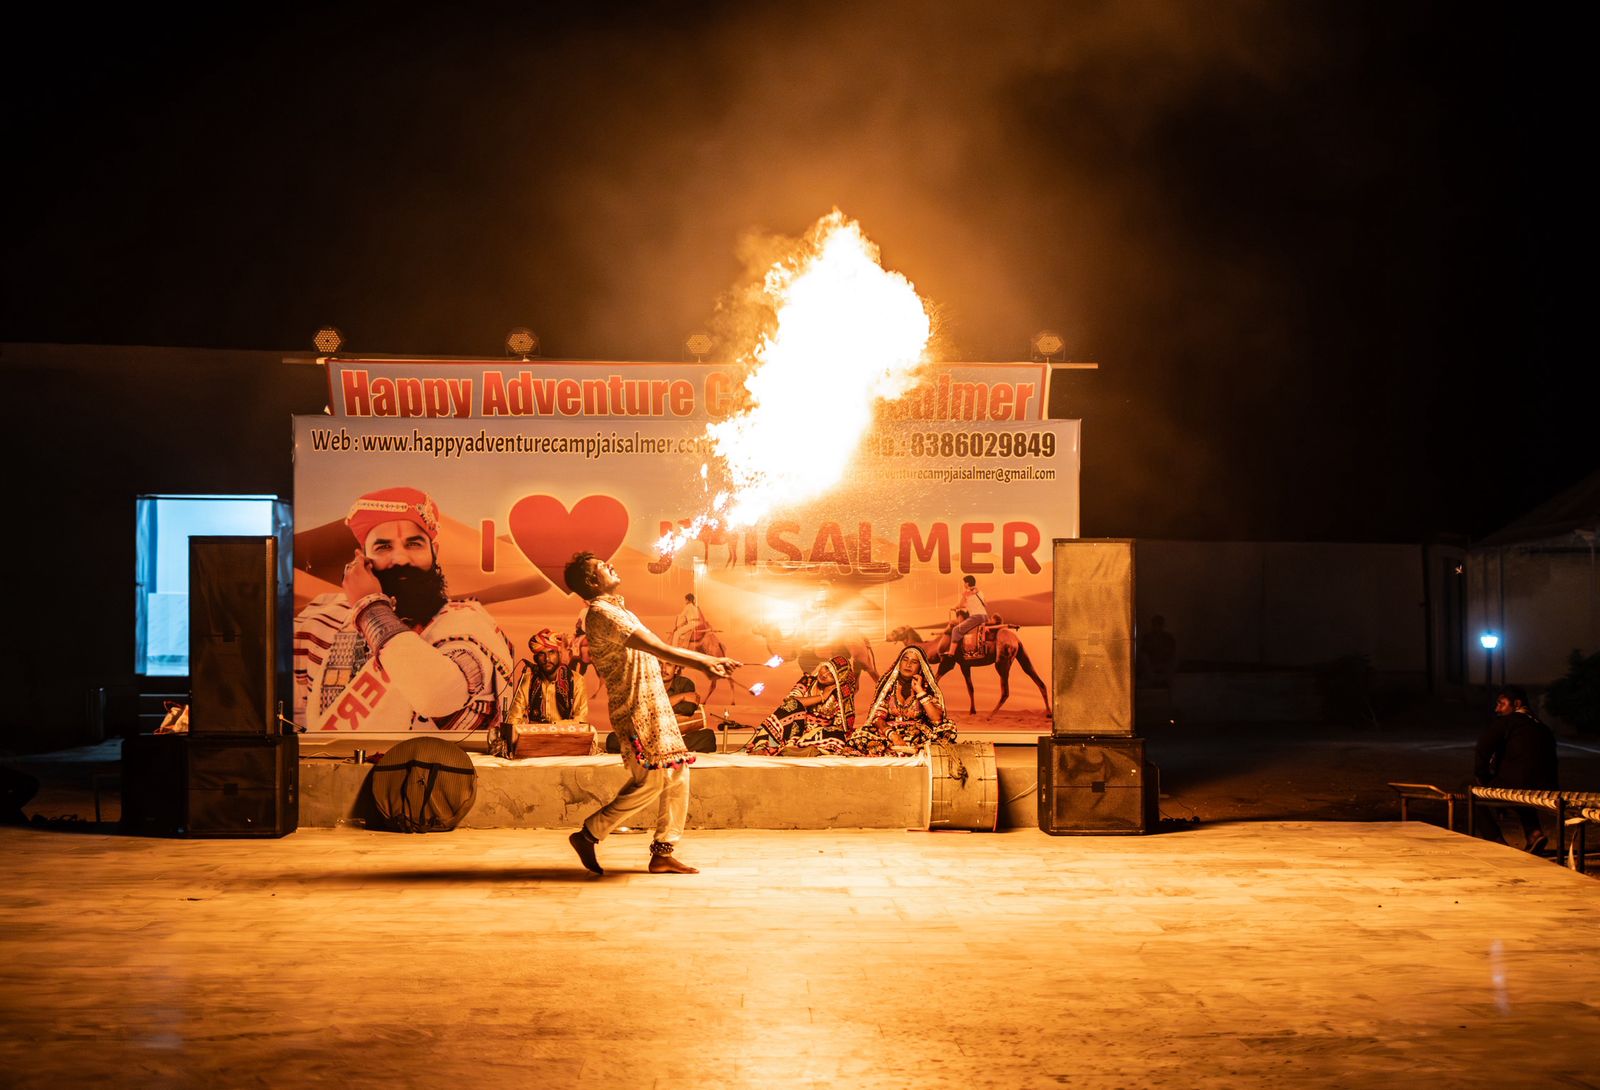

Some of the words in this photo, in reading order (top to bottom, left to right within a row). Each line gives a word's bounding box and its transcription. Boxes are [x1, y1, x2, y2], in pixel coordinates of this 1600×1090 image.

[341, 369, 472, 418] Happy
[482, 371, 695, 417] Adventure
[910, 431, 1056, 458] 8386029849
[647, 519, 1042, 575] JISALMER
